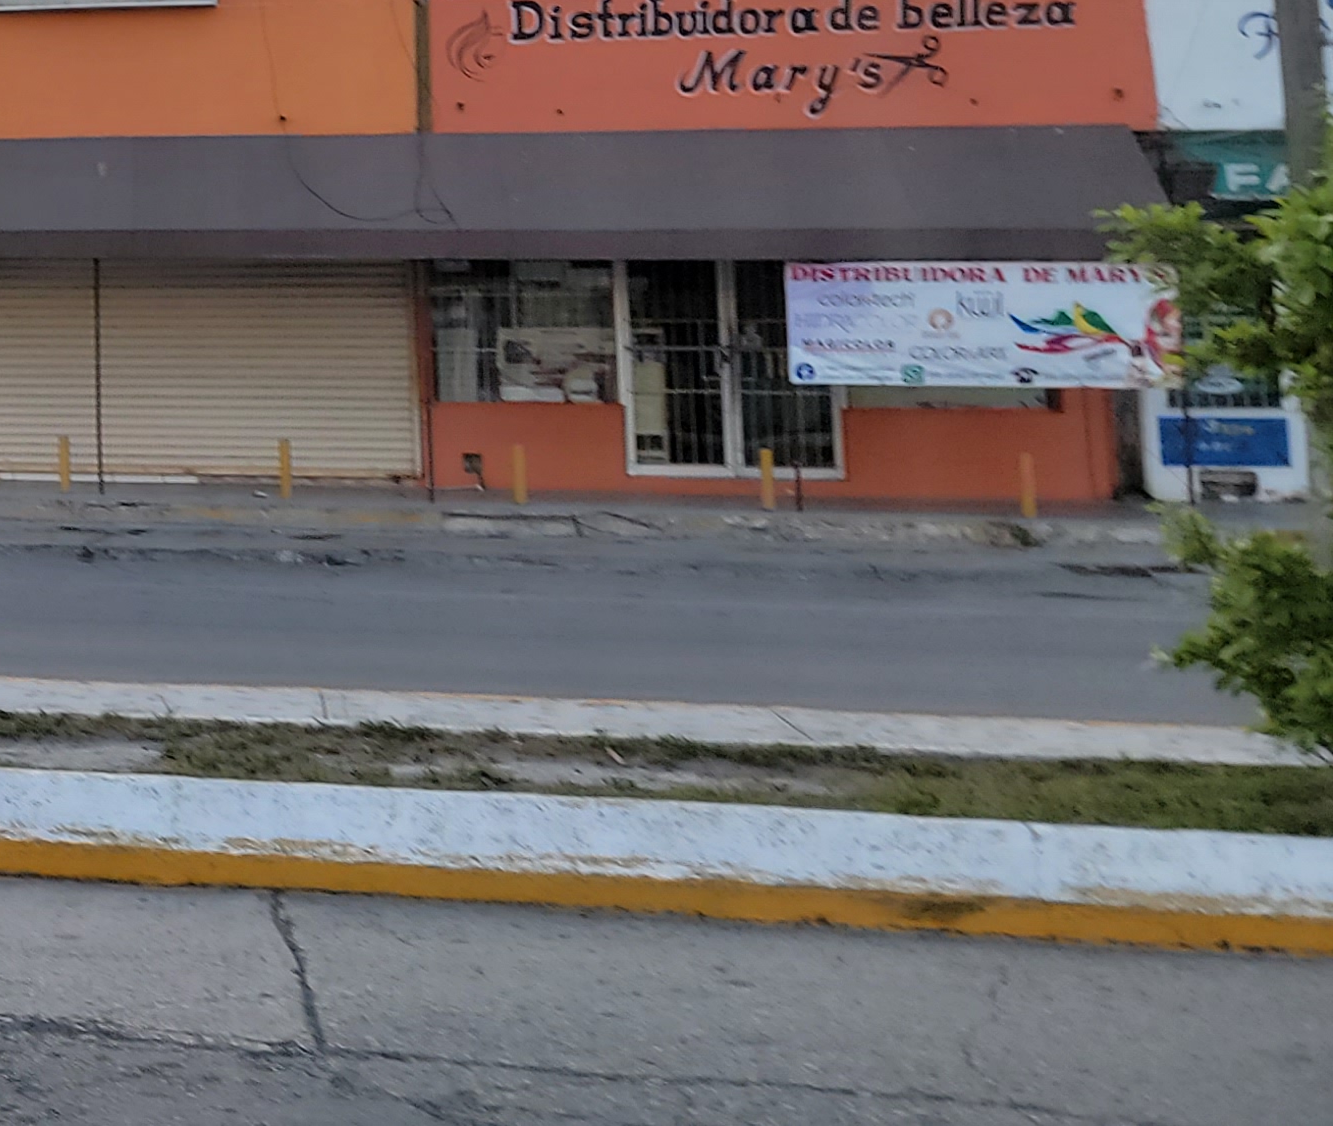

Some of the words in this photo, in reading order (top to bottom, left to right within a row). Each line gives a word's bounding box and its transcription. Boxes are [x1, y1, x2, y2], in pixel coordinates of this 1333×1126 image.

[676, 47, 884, 119] Mary's
[790, 265, 1007, 283] DISTRIBUIDORA
[1023, 266, 1057, 283] DE
